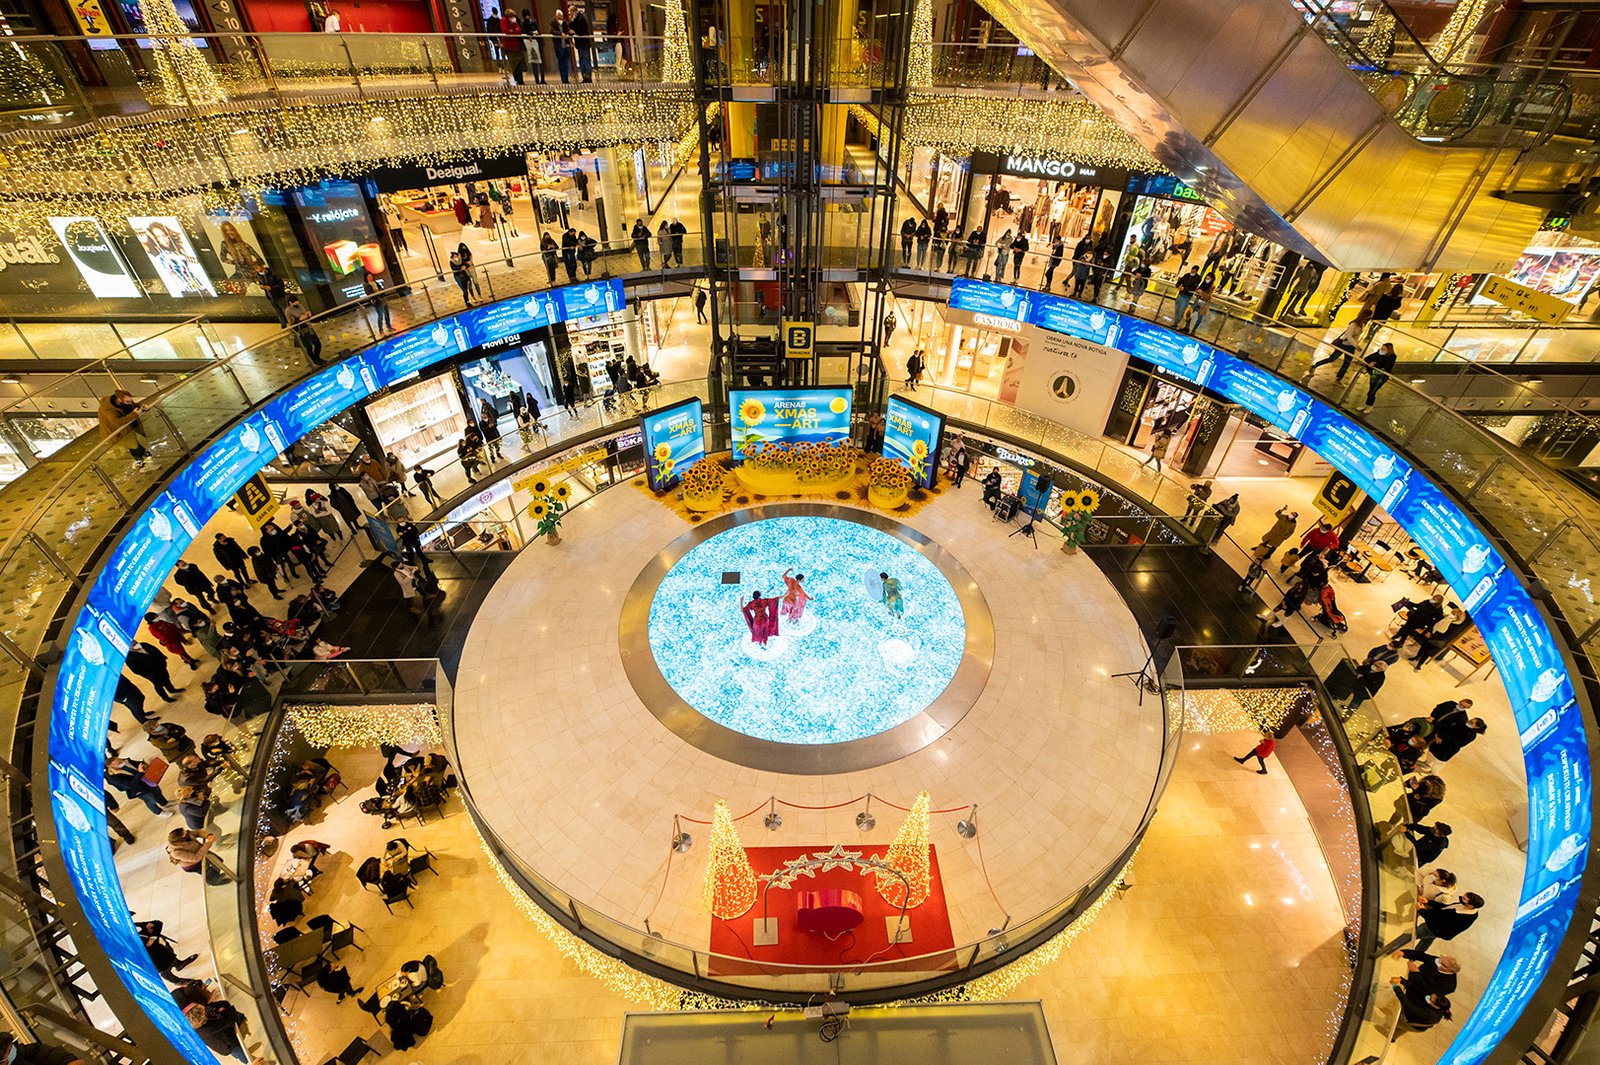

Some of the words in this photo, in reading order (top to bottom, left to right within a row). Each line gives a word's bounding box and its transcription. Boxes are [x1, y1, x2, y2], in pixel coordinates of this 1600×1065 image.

[221, 0, 230, 14] 9
[452, 7, 460, 18] 3
[224, 17, 240, 31] 10
[456, 22, 462, 32] 4
[462, 48, 470, 60] 6
[426, 162, 479, 180] Desigual
[1006, 156, 1076, 178] MANGO
[974, 313, 1020, 331] PANDORA
[794, 330, 806, 346] B
[774, 408, 817, 419] XMAS
[889, 414, 912, 428] XMAS
[669, 418, 694, 434] XMAS
[245, 482, 267, 510] A
[1330, 479, 1350, 504] C
